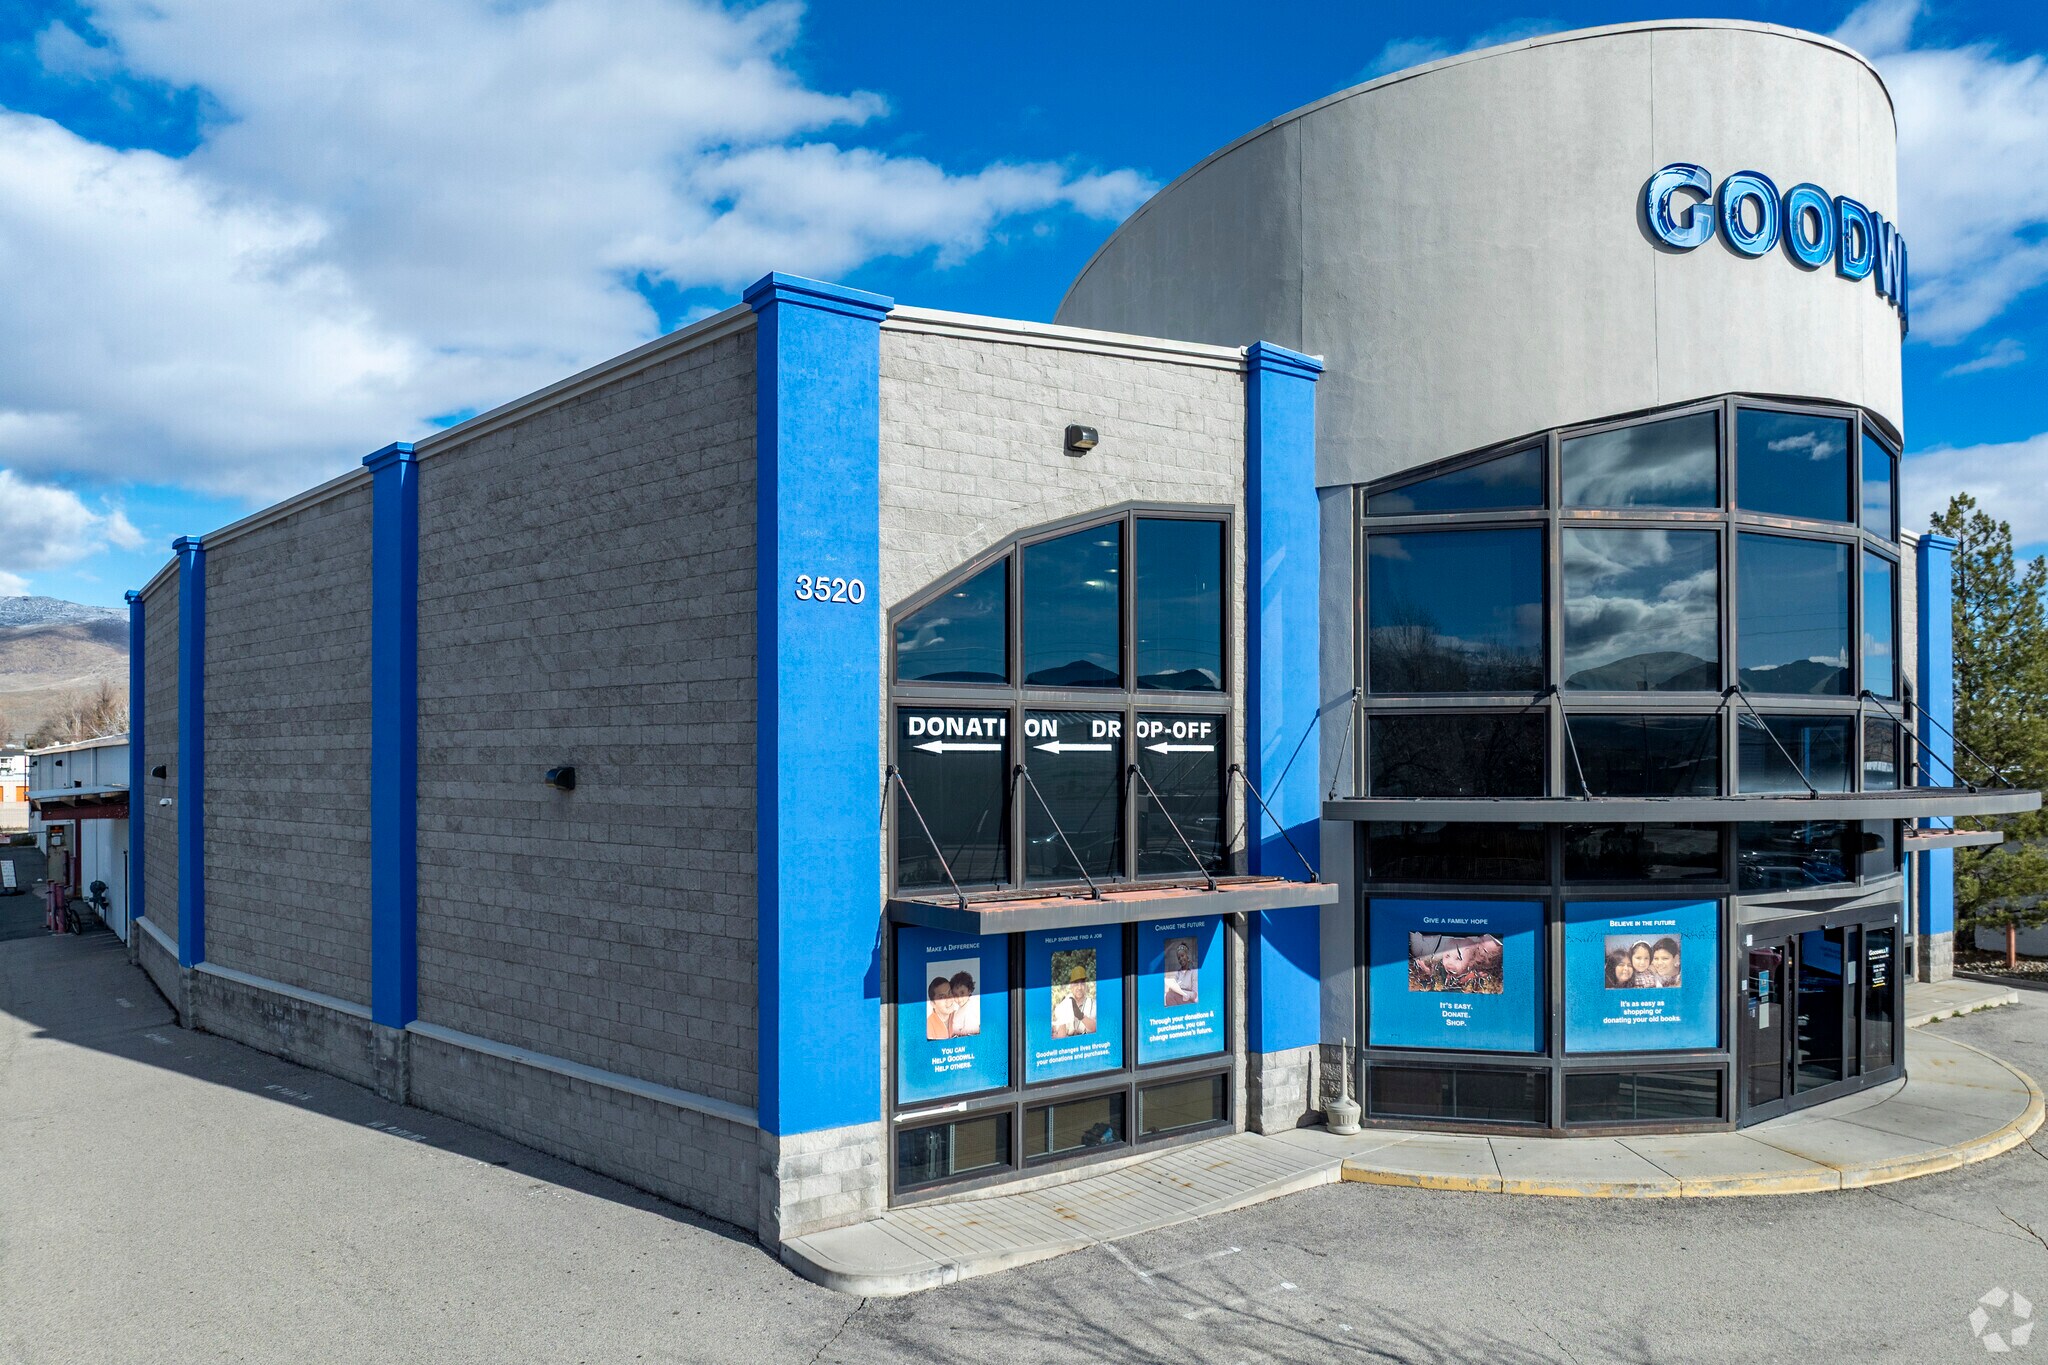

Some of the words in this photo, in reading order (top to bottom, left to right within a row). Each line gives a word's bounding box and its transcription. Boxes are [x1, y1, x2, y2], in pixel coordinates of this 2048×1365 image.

[795, 574, 866, 604] 3520
[1423, 916, 1439, 924] GIVE
[1154, 924, 1176, 932] CHANGE
[948, 942, 980, 951] DIFFERENCE
[1603, 1016, 1631, 1024] donating
[1633, 1016, 1648, 1024] your
